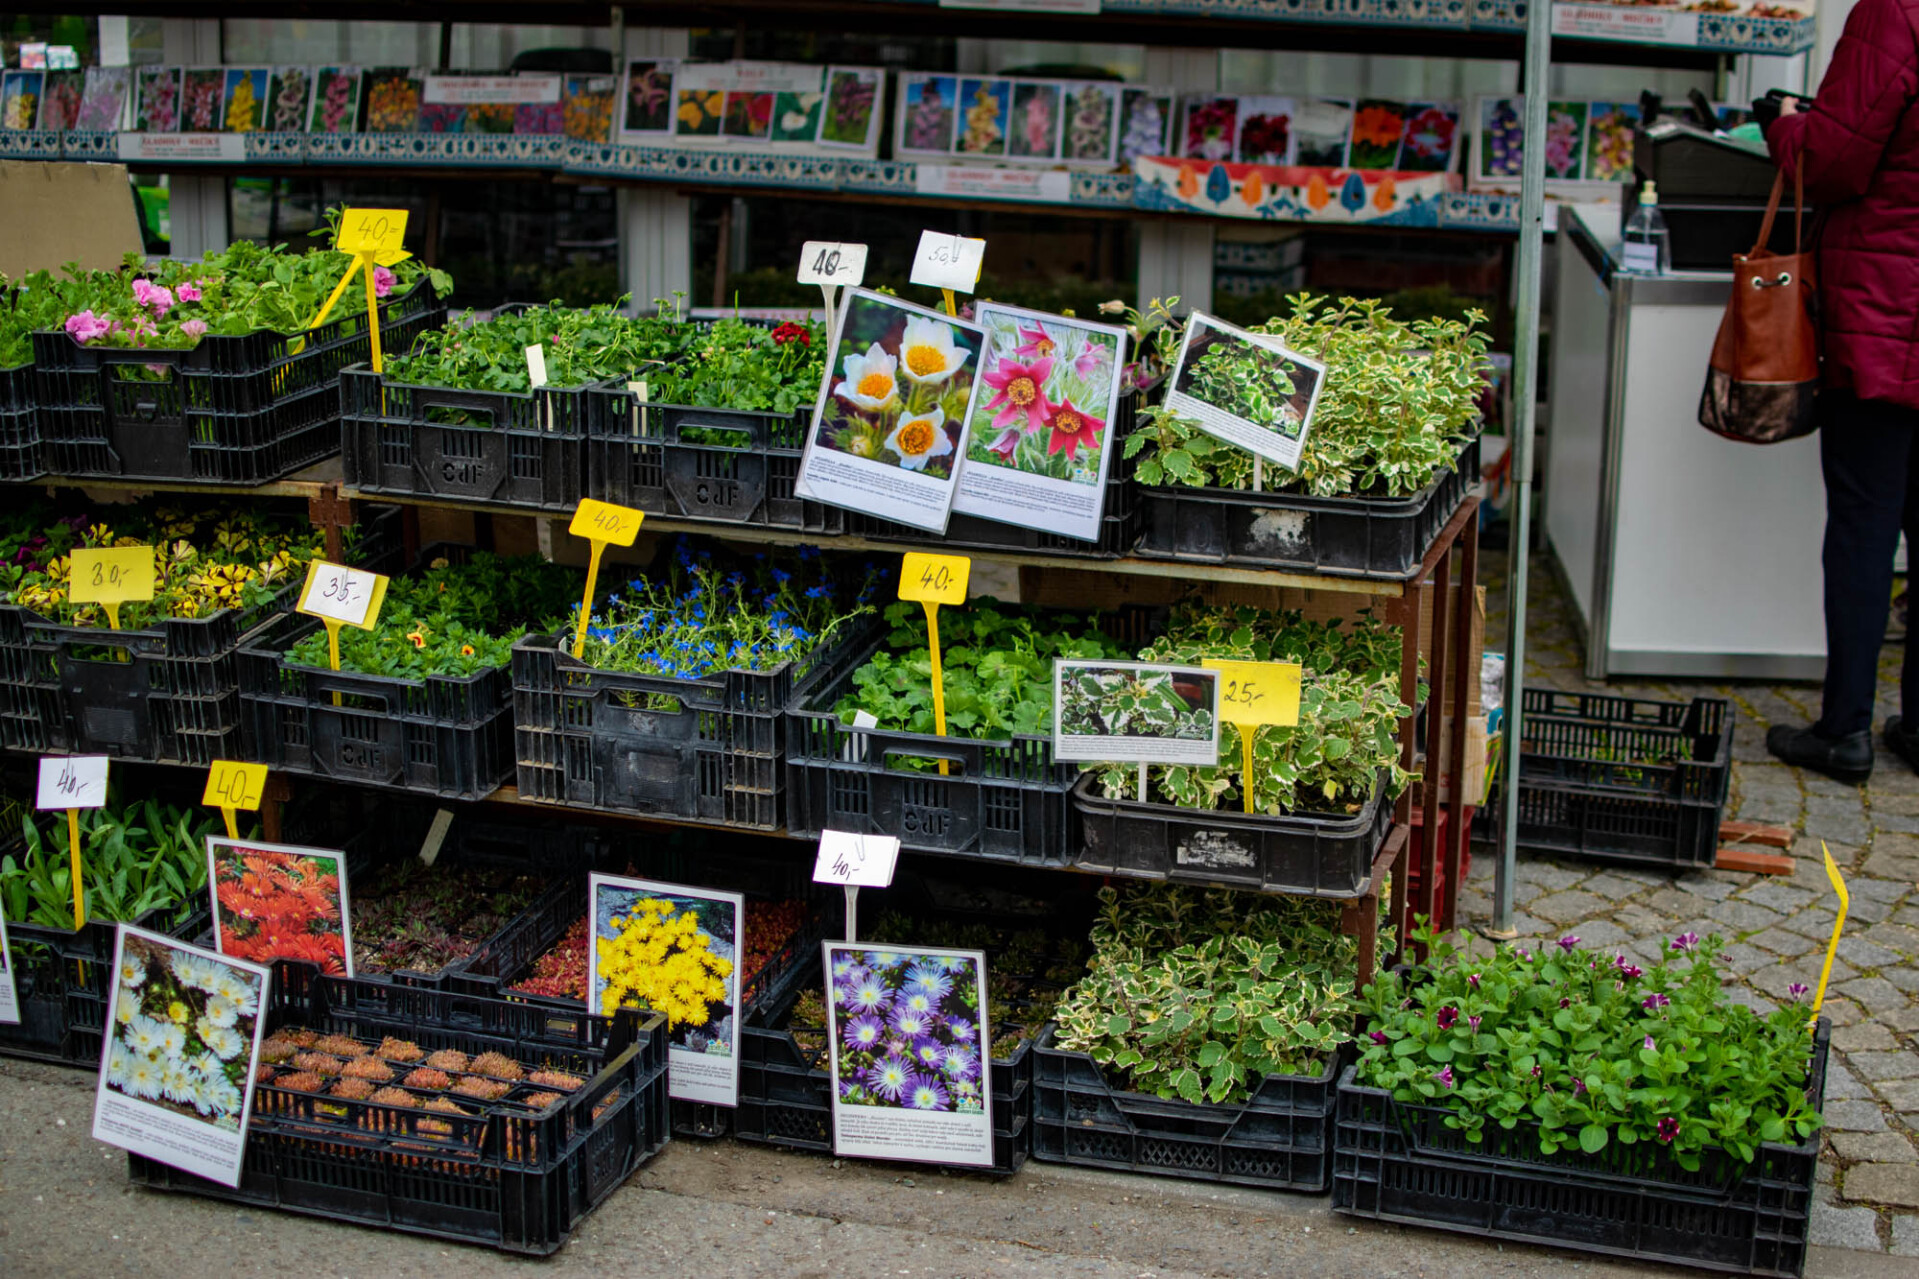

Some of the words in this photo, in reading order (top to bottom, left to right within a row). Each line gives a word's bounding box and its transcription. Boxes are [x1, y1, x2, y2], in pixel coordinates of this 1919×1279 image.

[1223, 680, 1265, 708] 25,-
[216, 768, 257, 808] 40,-
[831, 852, 860, 881] 40,-
